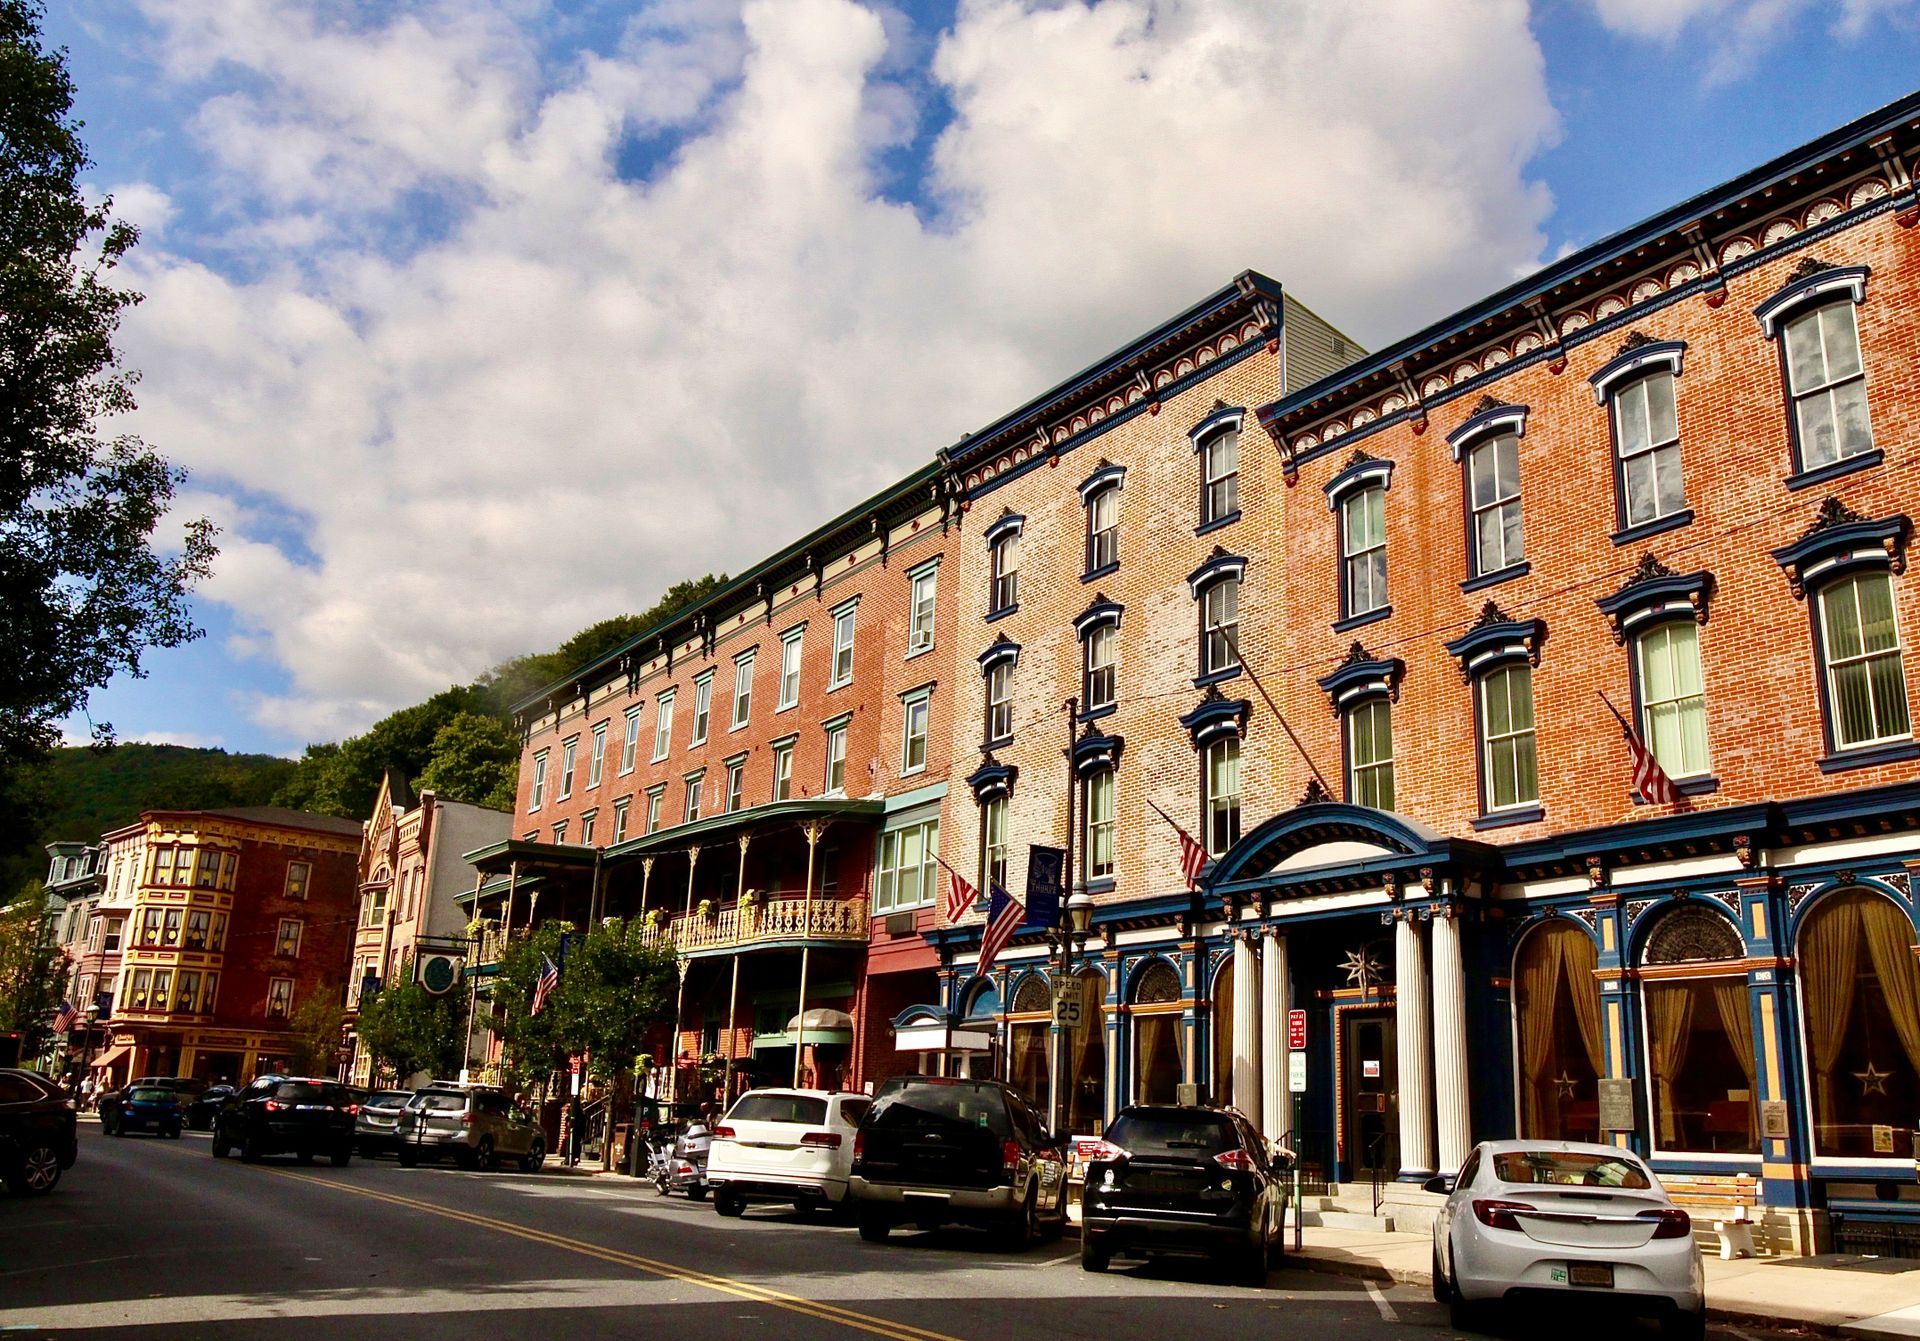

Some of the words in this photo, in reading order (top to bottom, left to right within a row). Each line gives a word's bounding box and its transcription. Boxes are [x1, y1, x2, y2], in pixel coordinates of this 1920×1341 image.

[1053, 980, 1082, 991] SPEED
[1057, 991, 1079, 1000] LIMIT
[1057, 1000, 1080, 1021] 25
[643, 1107, 649, 1116] P
